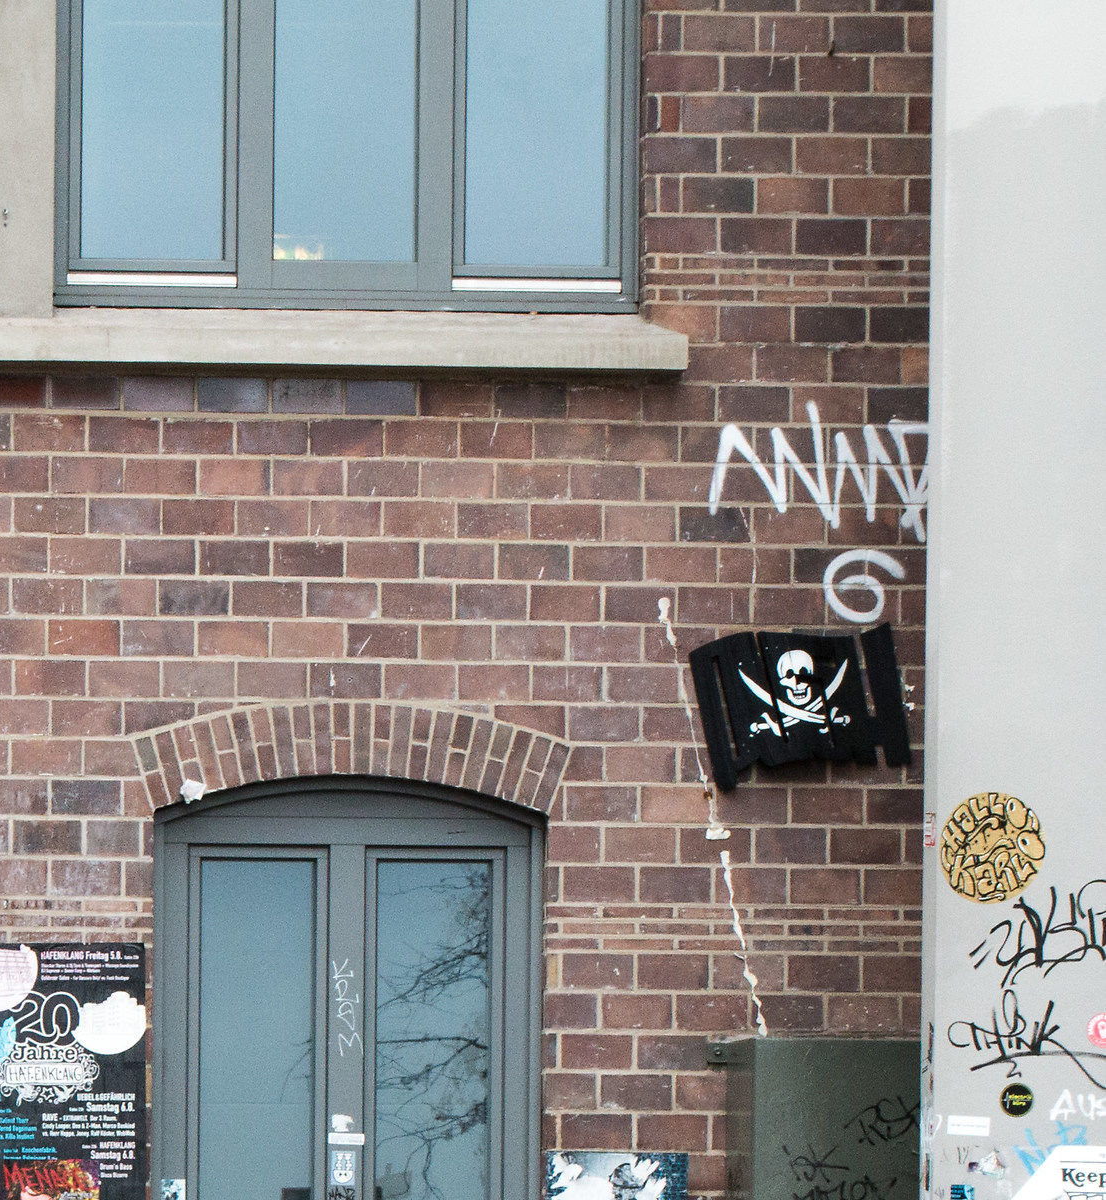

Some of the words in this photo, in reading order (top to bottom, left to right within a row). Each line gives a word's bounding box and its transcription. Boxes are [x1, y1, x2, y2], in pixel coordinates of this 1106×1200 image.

[85, 951, 109, 962] Freitag
[9, 991, 80, 1046] 20
[11, 1045, 79, 1062] Jahre
[86, 1102, 120, 1114] Samstag
[120, 1102, 135, 1112] 6.8.
[90, 1150, 121, 1161] Samstag
[122, 1150, 135, 1159] 6.8.
